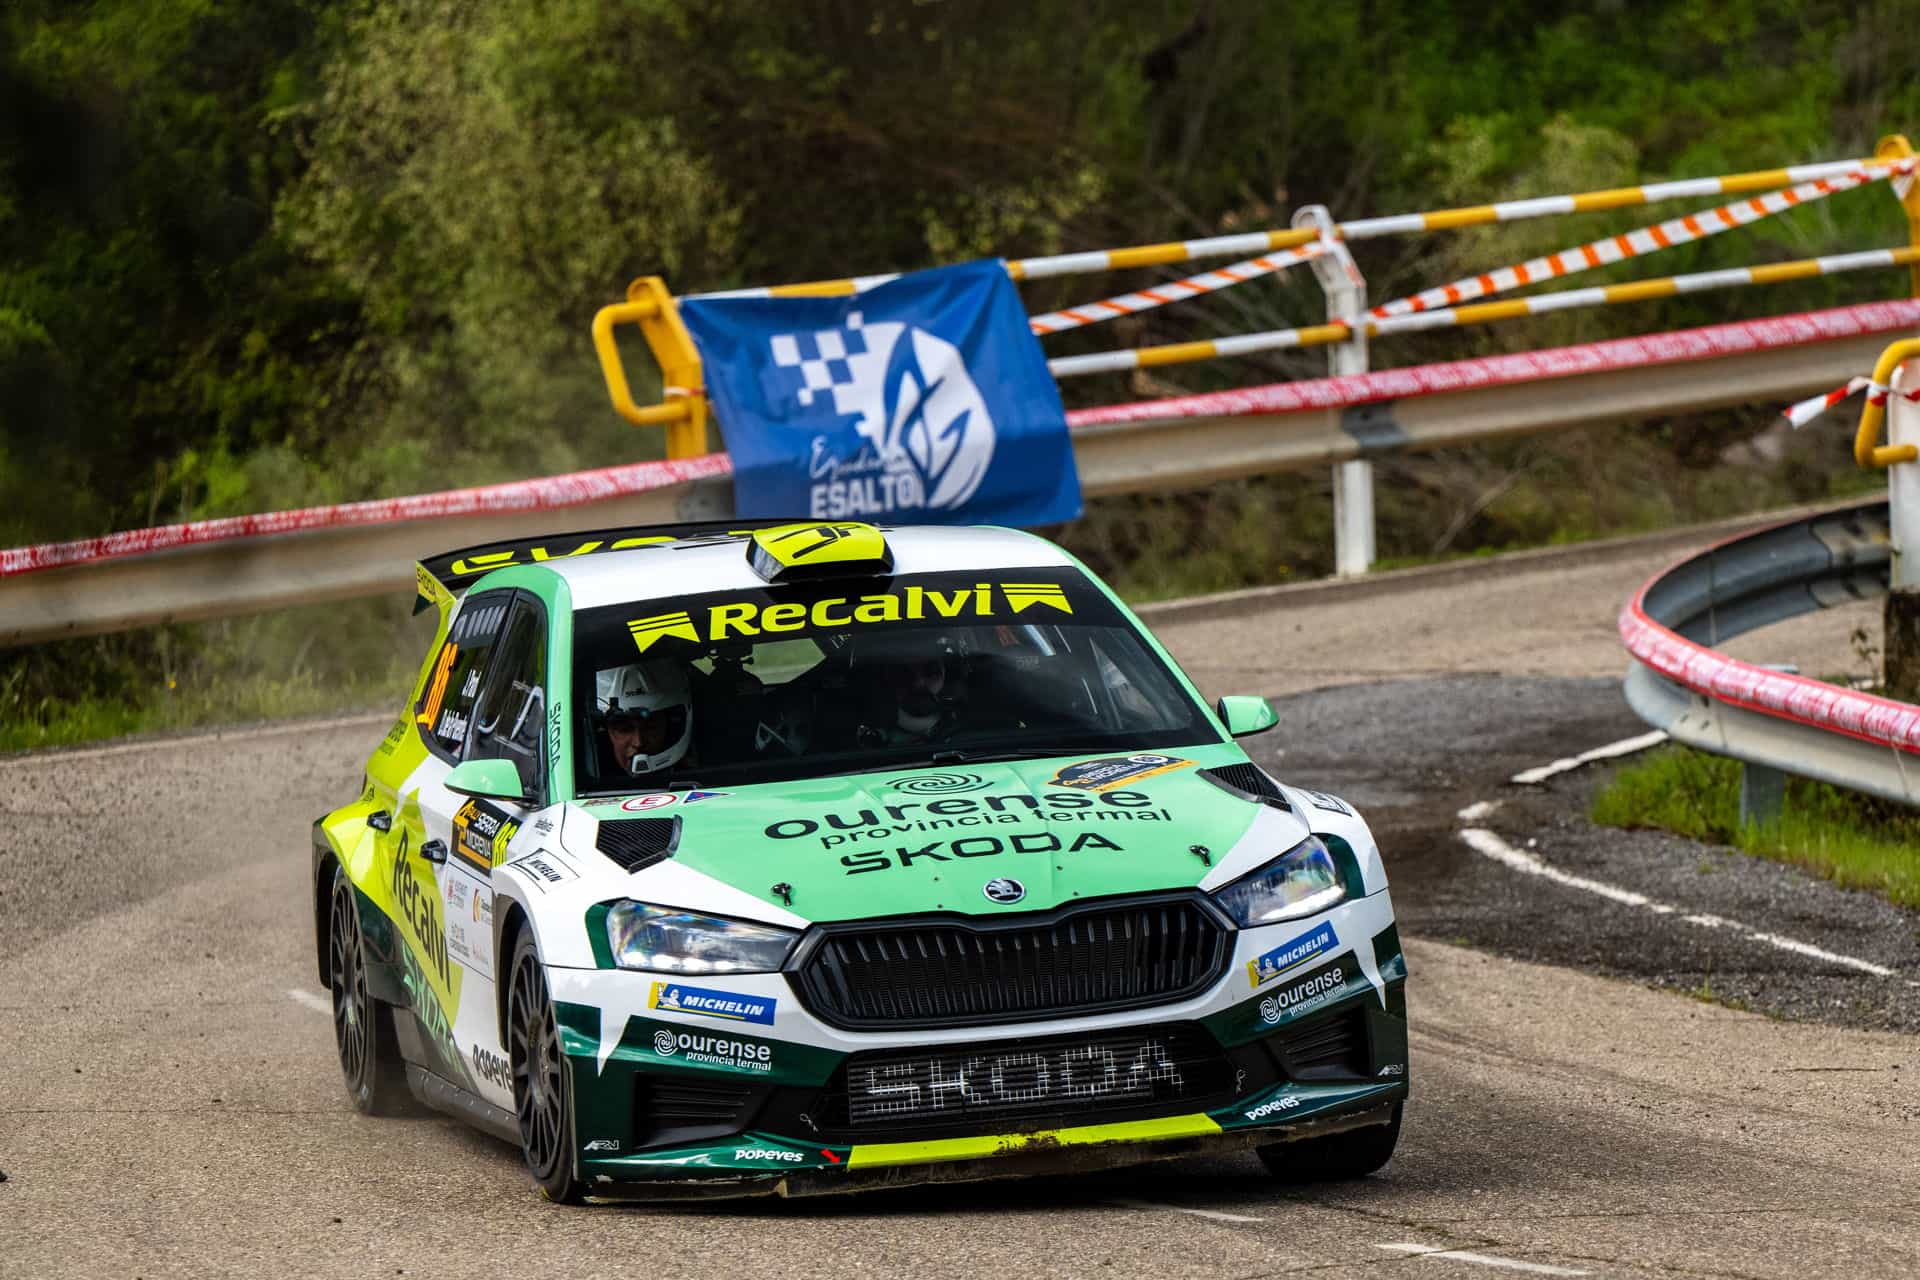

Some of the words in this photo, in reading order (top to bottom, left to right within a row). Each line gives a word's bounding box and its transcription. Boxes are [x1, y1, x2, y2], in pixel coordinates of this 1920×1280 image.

[810, 474, 914, 518] ESALTO
[707, 583, 995, 641] Recalvi
[550, 702, 561, 769] SKODA
[763, 791, 1152, 840] ourense
[820, 810, 1021, 850] provincia
[1033, 808, 1172, 822] termal
[841, 832, 1124, 875] SKODA
[393, 825, 451, 994] Recalvi
[1277, 932, 1329, 968] MICHELIN
[683, 995, 765, 1016] MICHELIN
[1278, 968, 1343, 1008] ourense
[1289, 993, 1325, 1017] provincia
[678, 1033, 771, 1061] ourense
[686, 1051, 735, 1067] provincia
[737, 1058, 772, 1071] termal
[865, 1041, 1185, 1112] SKODA
